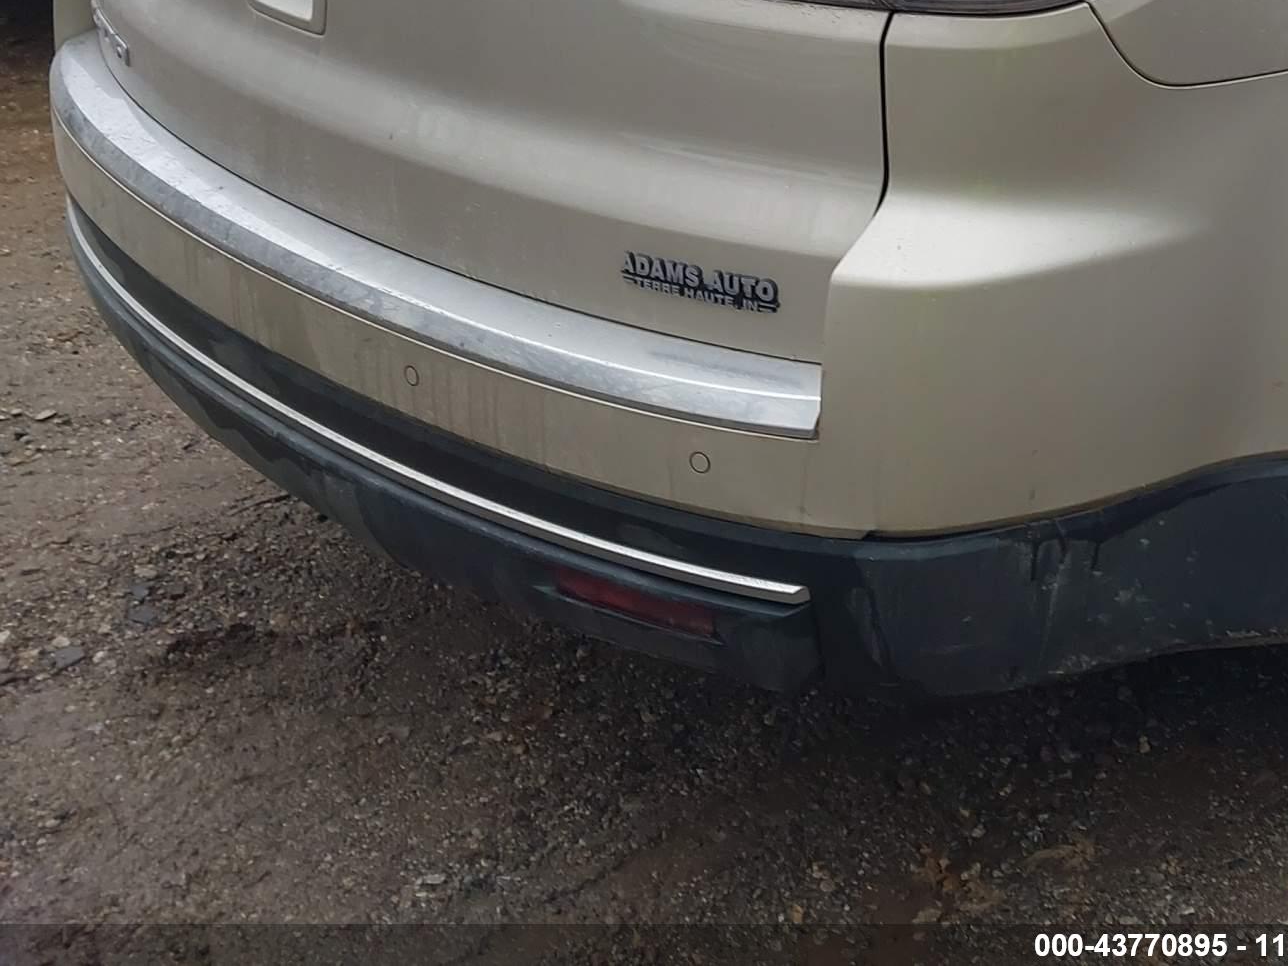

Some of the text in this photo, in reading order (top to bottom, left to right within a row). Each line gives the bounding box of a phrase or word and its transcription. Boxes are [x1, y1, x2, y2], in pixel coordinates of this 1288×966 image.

[622, 251, 777, 303] ADAMS AUTO
[635, 276, 680, 295] TERRE
[743, 300, 758, 313] IN
